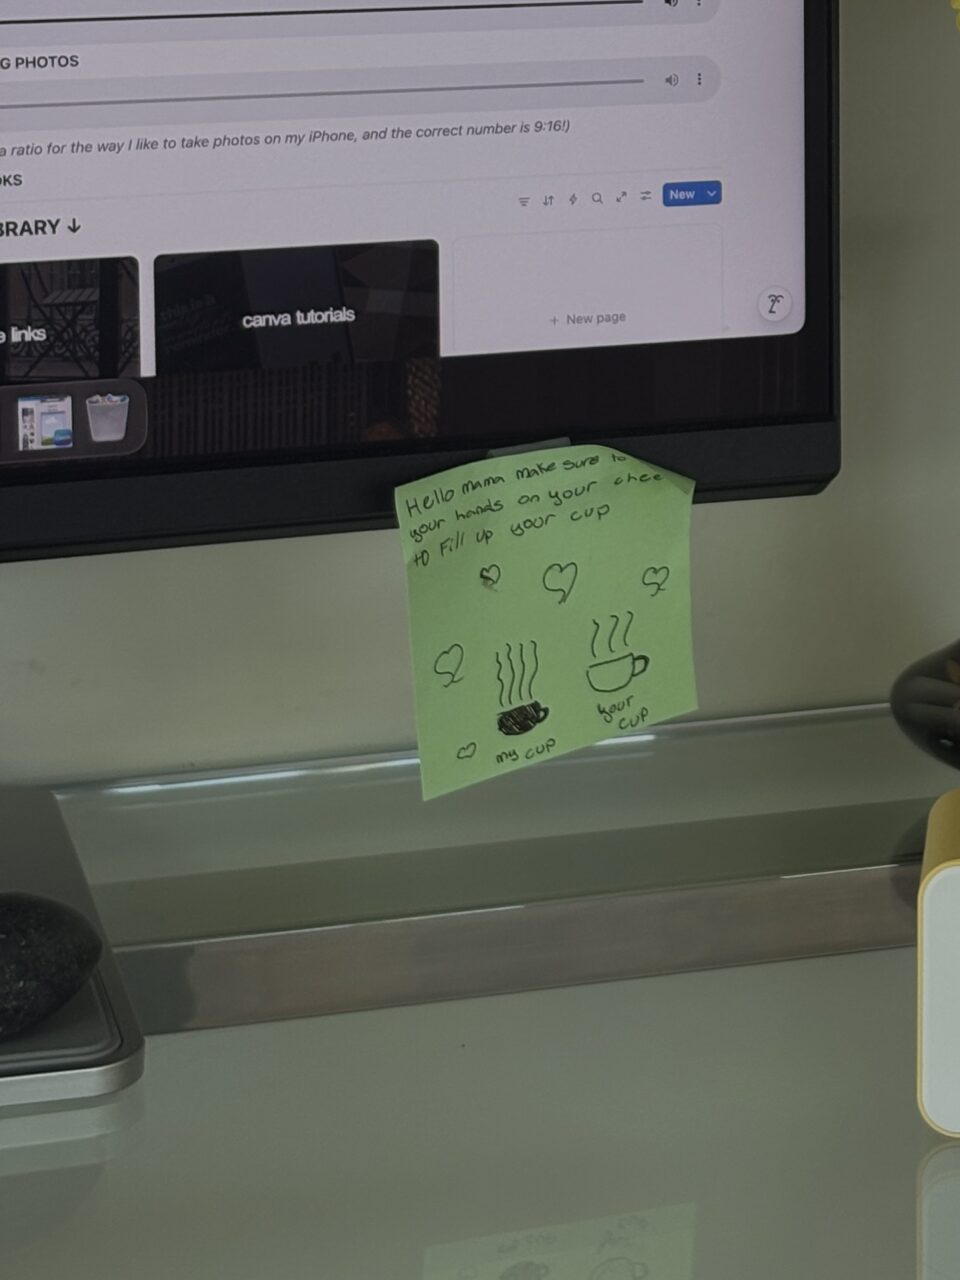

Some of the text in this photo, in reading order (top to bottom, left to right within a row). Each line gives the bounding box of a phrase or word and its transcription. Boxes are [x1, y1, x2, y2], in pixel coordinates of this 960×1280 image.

[0, 55, 79, 70] G PHOTOS
[11, 143, 43, 156] ratio
[47, 142, 67, 154] for
[71, 141, 92, 153] the
[98, 142, 124, 154] way
[128, 139, 132, 151] I
[136, 138, 158, 150] like
[163, 139, 176, 149] to
[181, 136, 209, 148] take
[213, 135, 260, 149] photos
[264, 135, 281, 144] on
[285, 134, 305, 146] my
[309, 130, 357, 142] iPhone,
[362, 128, 388, 140] and
[392, 127, 412, 139] the
[416, 126, 462, 138] correct
[467, 123, 517, 135] number
[520, 122, 530, 133] is
[534, 120, 570, 133] 9:16!)
[670, 190, 695, 200] New
[243, 306, 355, 329] canva tutorials
[566, 311, 626, 324] New page
[11, 325, 47, 343] links
[405, 487, 455, 517] Hello
[410, 518, 444, 542] your
[455, 501, 504, 520] hands
[518, 493, 540, 505] on
[549, 481, 597, 506] your
[476, 529, 493, 544] up
[510, 514, 556, 536] your
[570, 504, 610, 521] cup
[596, 695, 634, 722] your
[618, 707, 649, 730] cup
[496, 738, 556, 763] my cup
